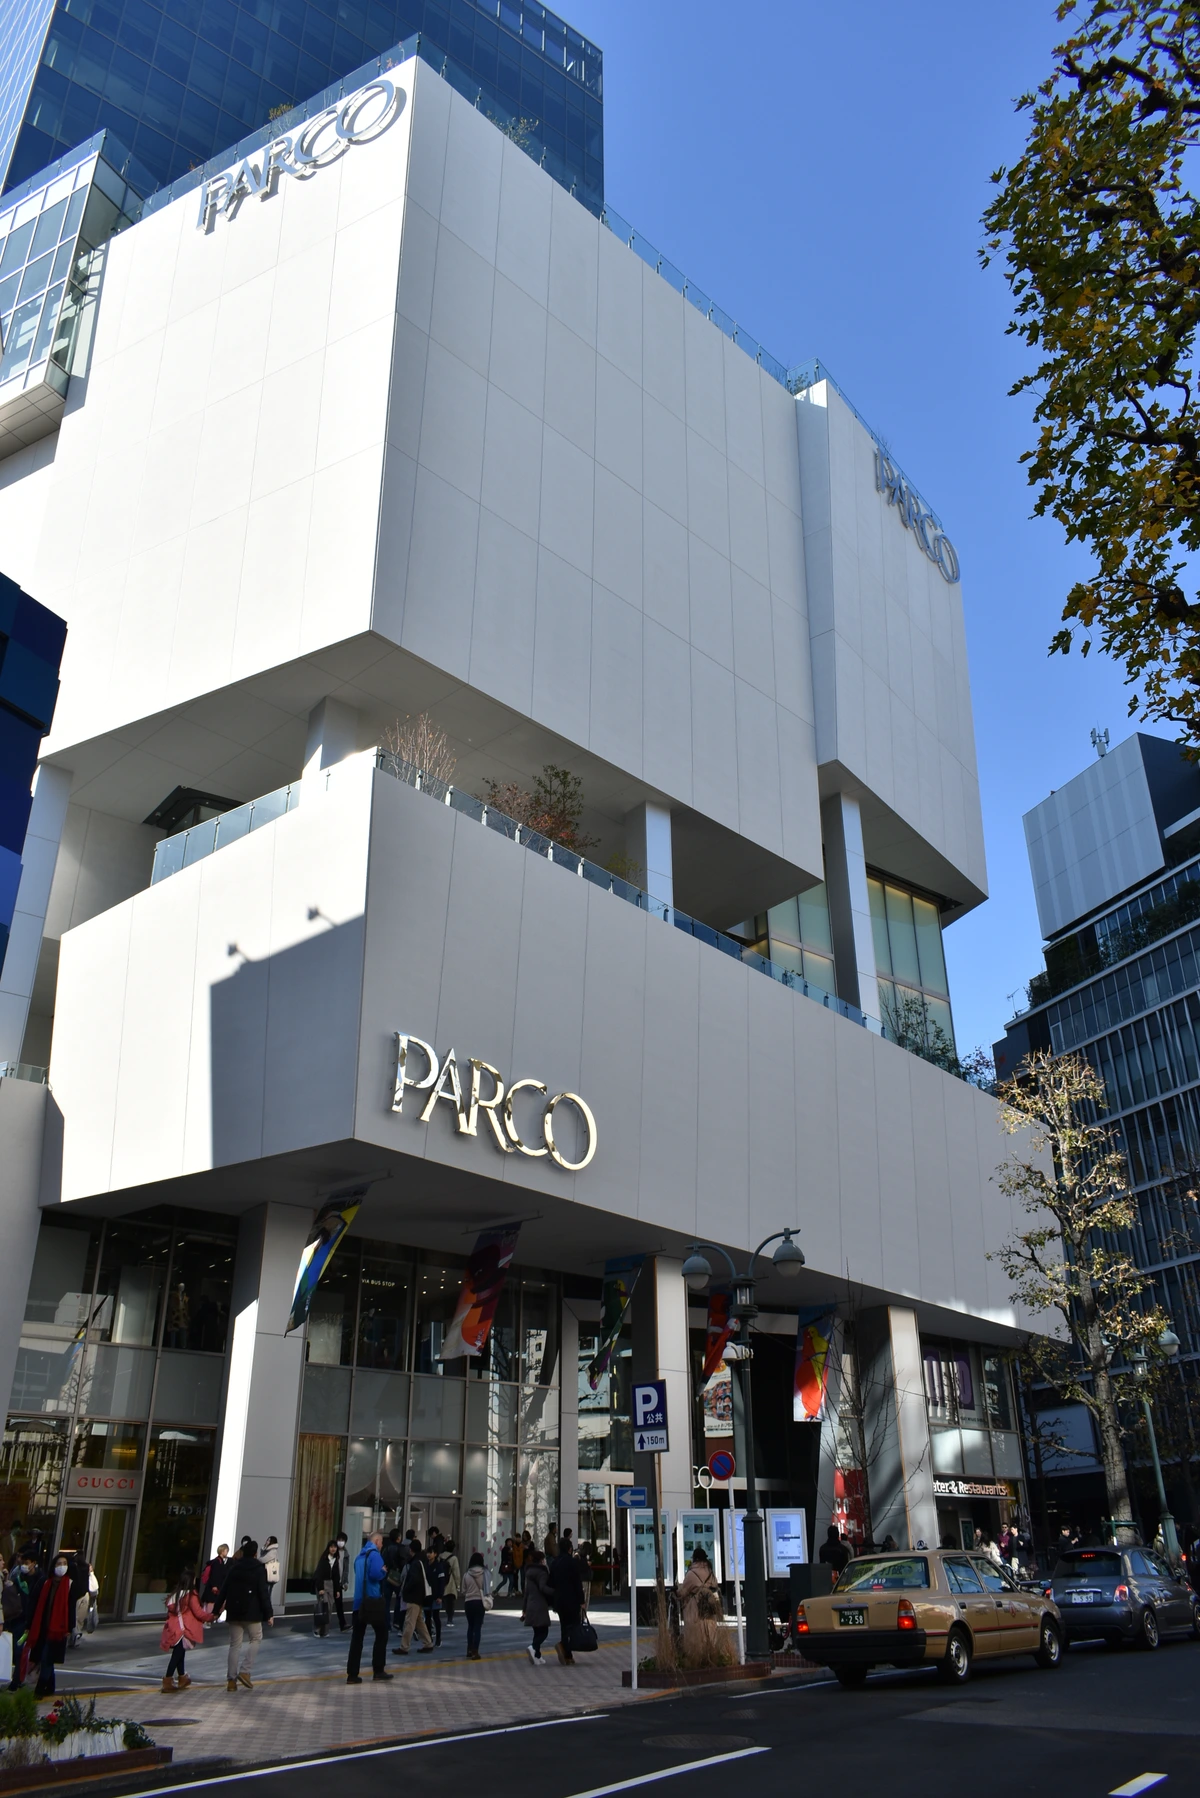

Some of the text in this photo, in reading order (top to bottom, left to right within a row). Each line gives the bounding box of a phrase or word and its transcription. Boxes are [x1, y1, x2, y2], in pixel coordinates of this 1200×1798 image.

[197, 79, 396, 231] PARCO
[874, 448, 960, 583] PARCO
[392, 1031, 597, 1170] PARCO
[635, 1386, 658, 1426] P
[646, 1412, 663, 1424] 公共
[647, 1436, 665, 1445] 150m
[77, 1476, 134, 1489] GUCCI
[959, 1481, 1006, 1496] Restaurants
